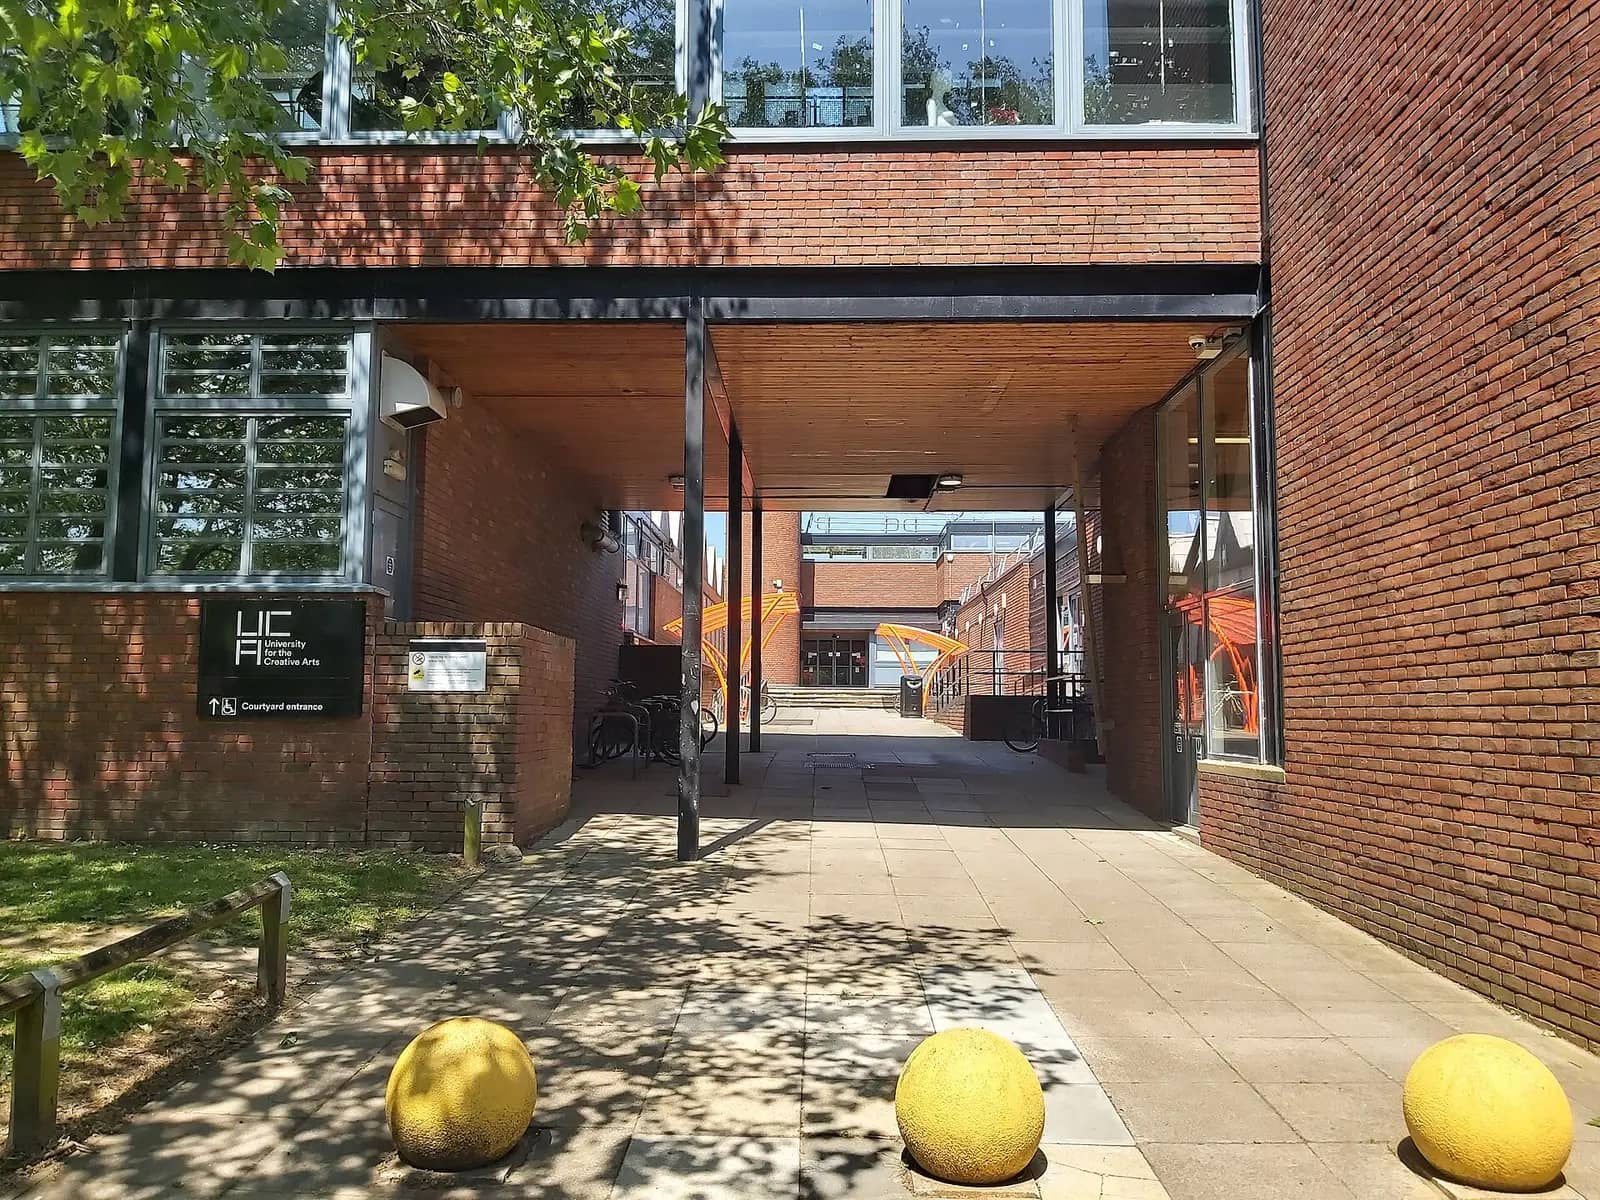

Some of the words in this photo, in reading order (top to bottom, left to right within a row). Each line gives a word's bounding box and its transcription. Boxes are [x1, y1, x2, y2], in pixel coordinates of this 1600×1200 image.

[264, 639, 307, 649] University
[264, 649, 277, 657] for
[278, 649, 292, 657] the
[263, 657, 300, 666] Creative
[301, 657, 320, 666] Arts
[241, 702, 285, 712] Courtyard
[286, 703, 323, 711] entrance
